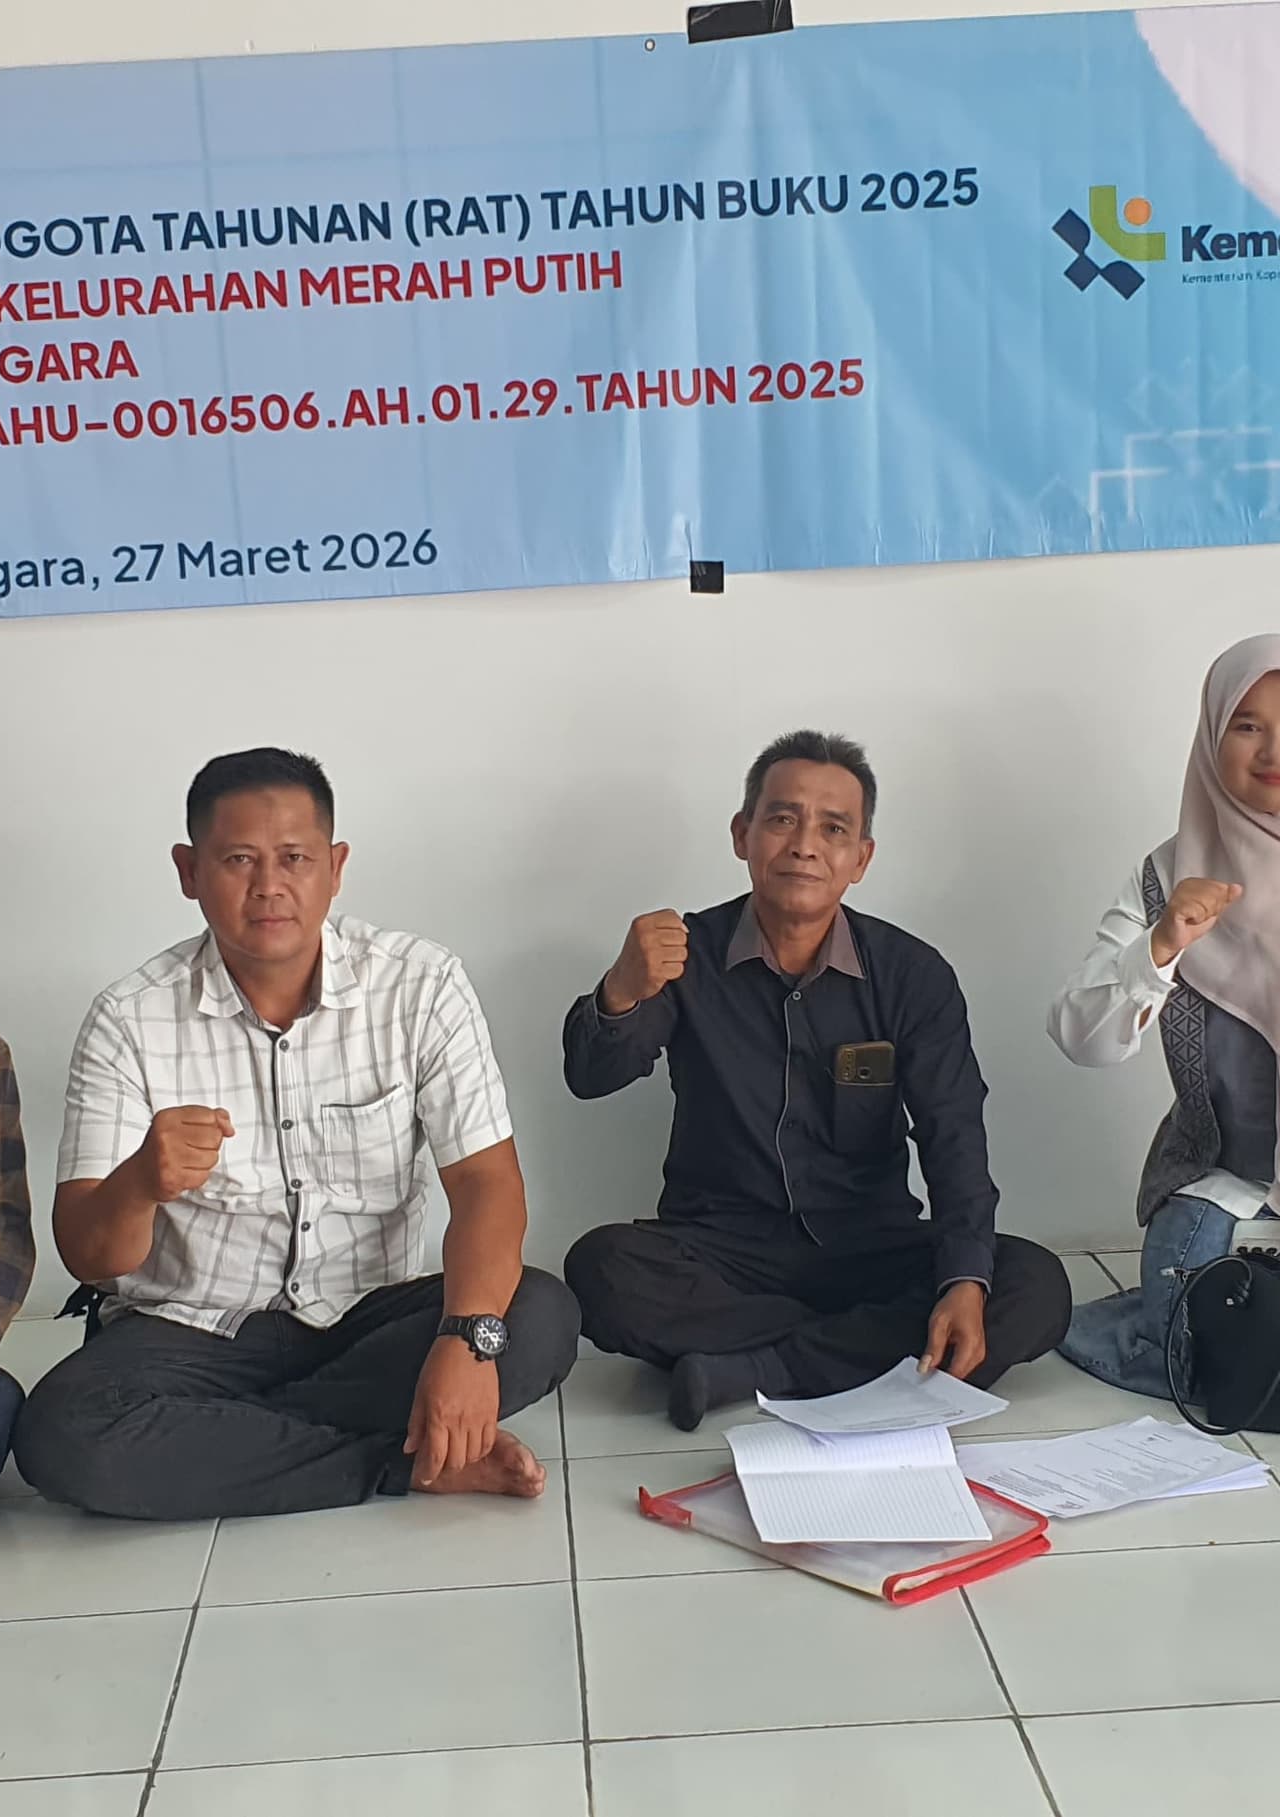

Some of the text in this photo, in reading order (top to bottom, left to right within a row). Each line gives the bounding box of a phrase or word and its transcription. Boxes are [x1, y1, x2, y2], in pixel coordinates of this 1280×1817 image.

[152, 201, 392, 250] TAHUNAN
[405, 193, 532, 246] (RAT)
[540, 181, 706, 231] TAHUN
[717, 174, 849, 220] BUKU
[860, 167, 979, 212] 2025
[299, 259, 473, 309] MERAH
[484, 250, 622, 297] PUTIH
[747, 358, 866, 403] 2025
[111, 543, 166, 583] 27
[176, 535, 312, 580] Maret
[320, 528, 438, 572] 2026
